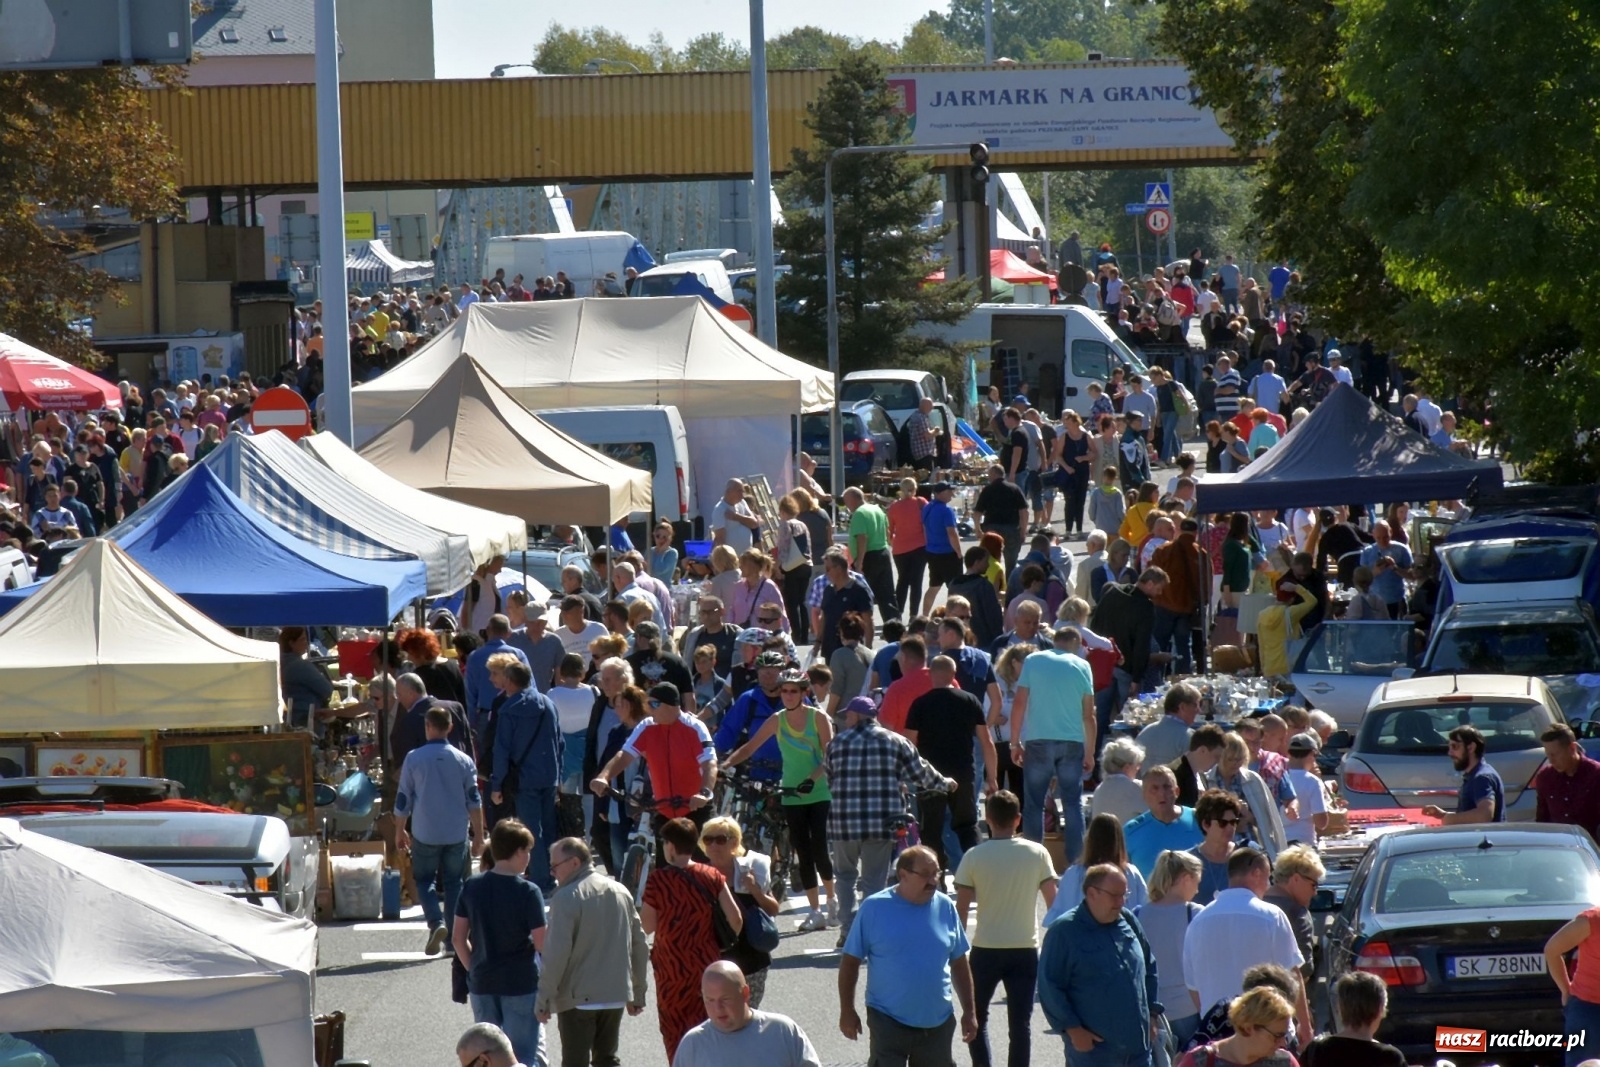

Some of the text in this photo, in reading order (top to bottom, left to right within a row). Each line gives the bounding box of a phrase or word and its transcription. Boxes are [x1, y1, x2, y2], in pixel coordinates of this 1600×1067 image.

[929, 88, 1048, 107] JARMARK
[1060, 86, 1095, 105] NA
[1458, 955, 1543, 976] SK 788NN
